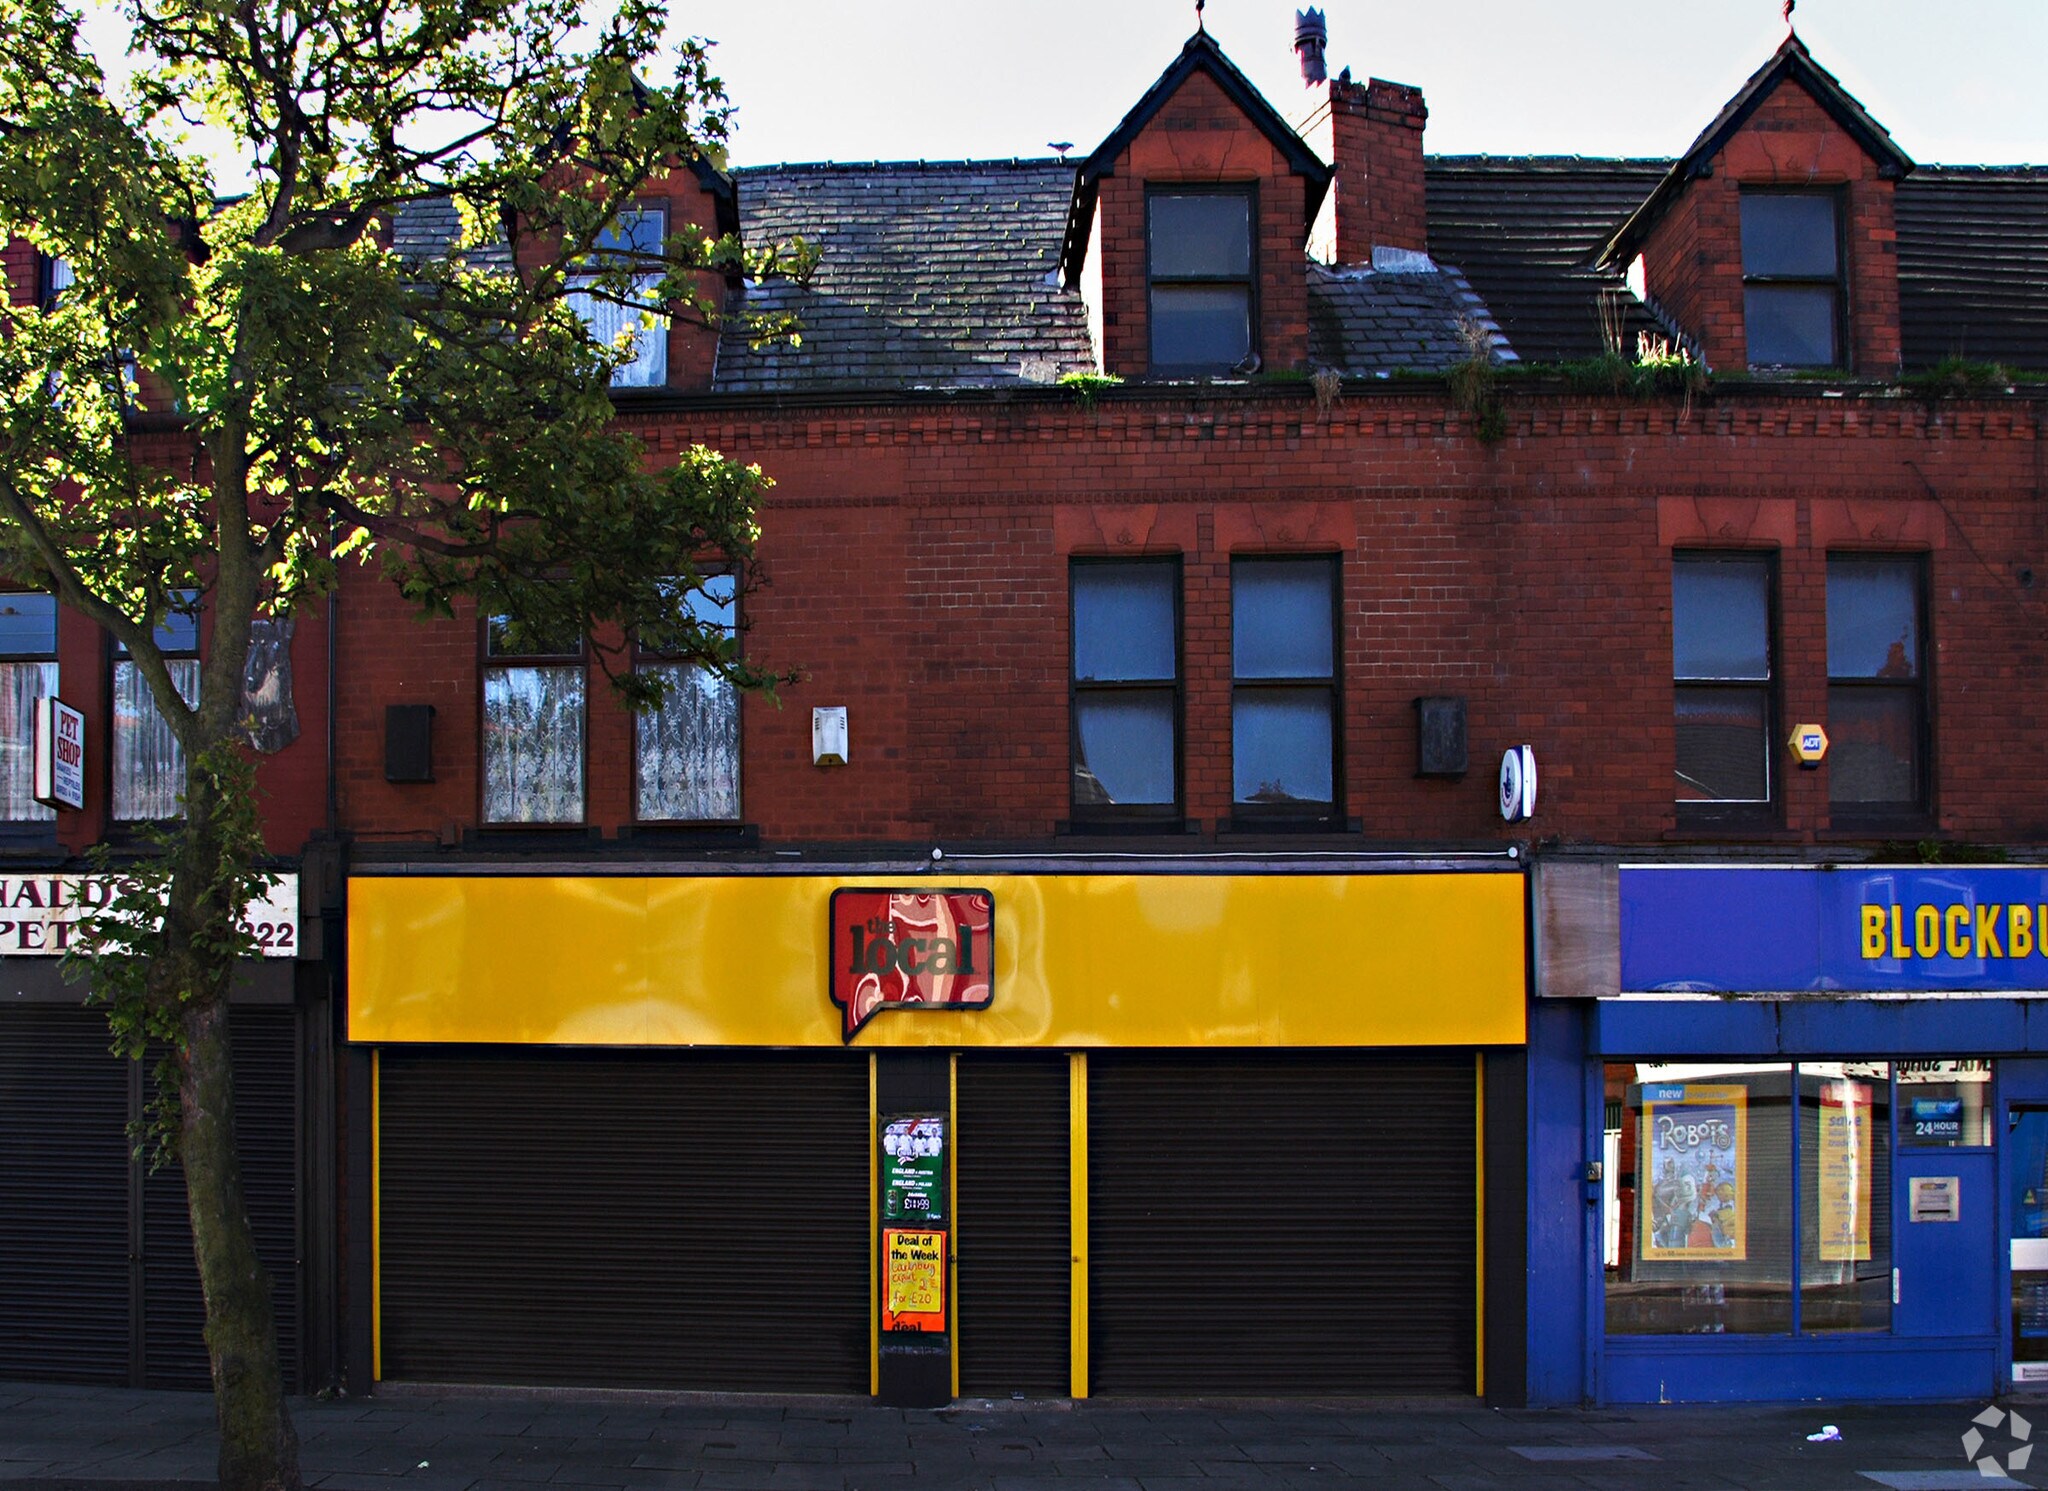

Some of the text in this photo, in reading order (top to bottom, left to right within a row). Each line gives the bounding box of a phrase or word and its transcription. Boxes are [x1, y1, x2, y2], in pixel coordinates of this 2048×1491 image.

[61, 710, 78, 740] PET
[1803, 737, 1821, 748] ADT
[57, 736, 80, 768] SHOP
[867, 916, 896, 934] the
[850, 925, 977, 975] local
[1658, 1089, 1683, 1098] new
[1915, 1121, 1958, 1135] 24 HOUR
[897, 1235, 933, 1246] Deal of
[891, 1249, 939, 1260] the Week
[910, 1291, 932, 1305] £20
